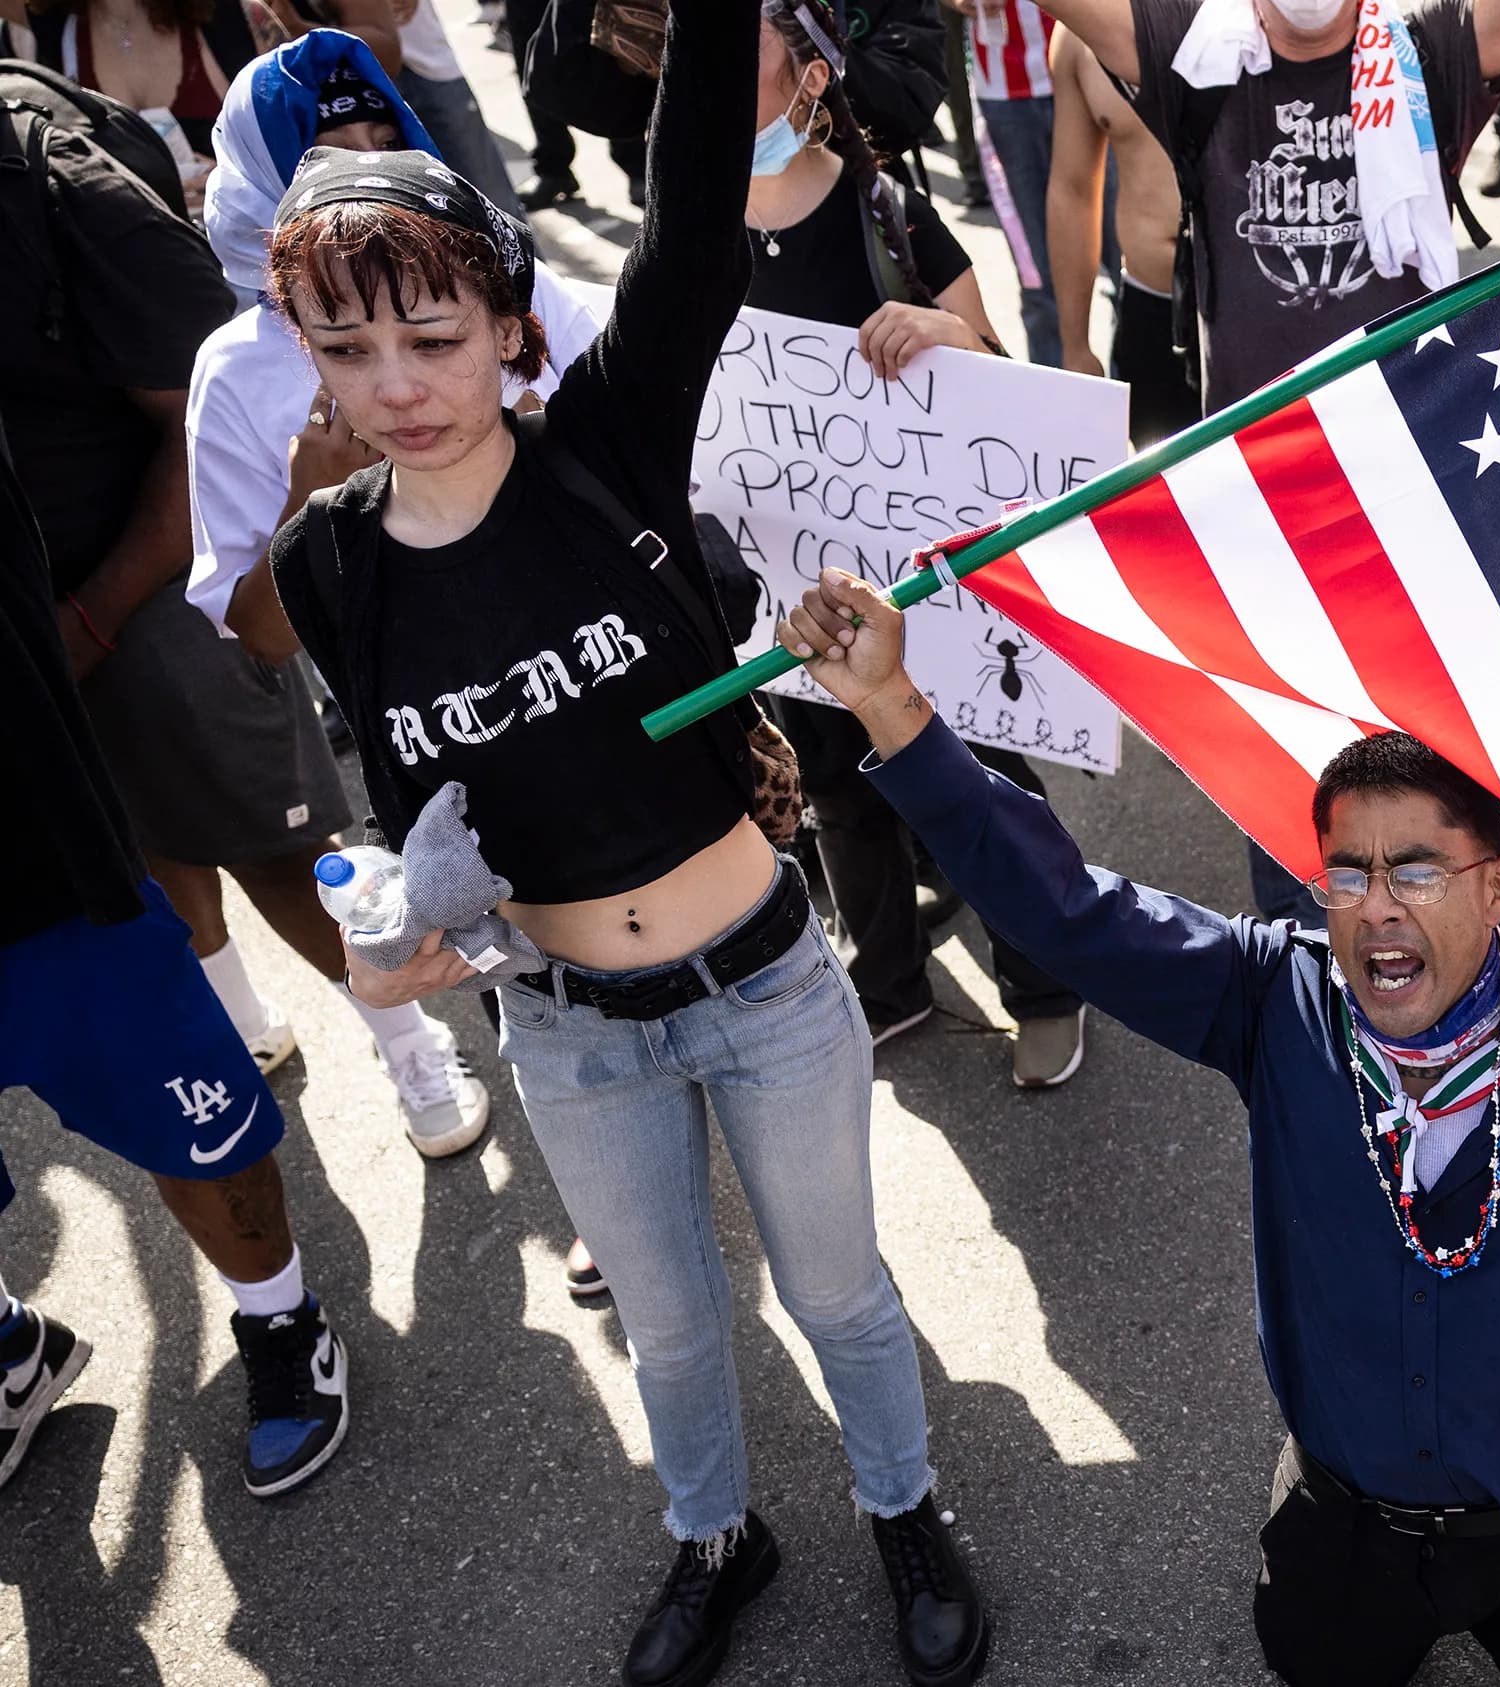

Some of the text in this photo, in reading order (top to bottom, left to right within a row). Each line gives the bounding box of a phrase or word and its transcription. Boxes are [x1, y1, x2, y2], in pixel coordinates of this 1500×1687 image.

[1278, 223, 1360, 243] Est. 1997
[968, 436, 1096, 501] DUE
[719, 448, 984, 542] PROCESS
[737, 516, 767, 564] A
[164, 1076, 233, 1125] LA
